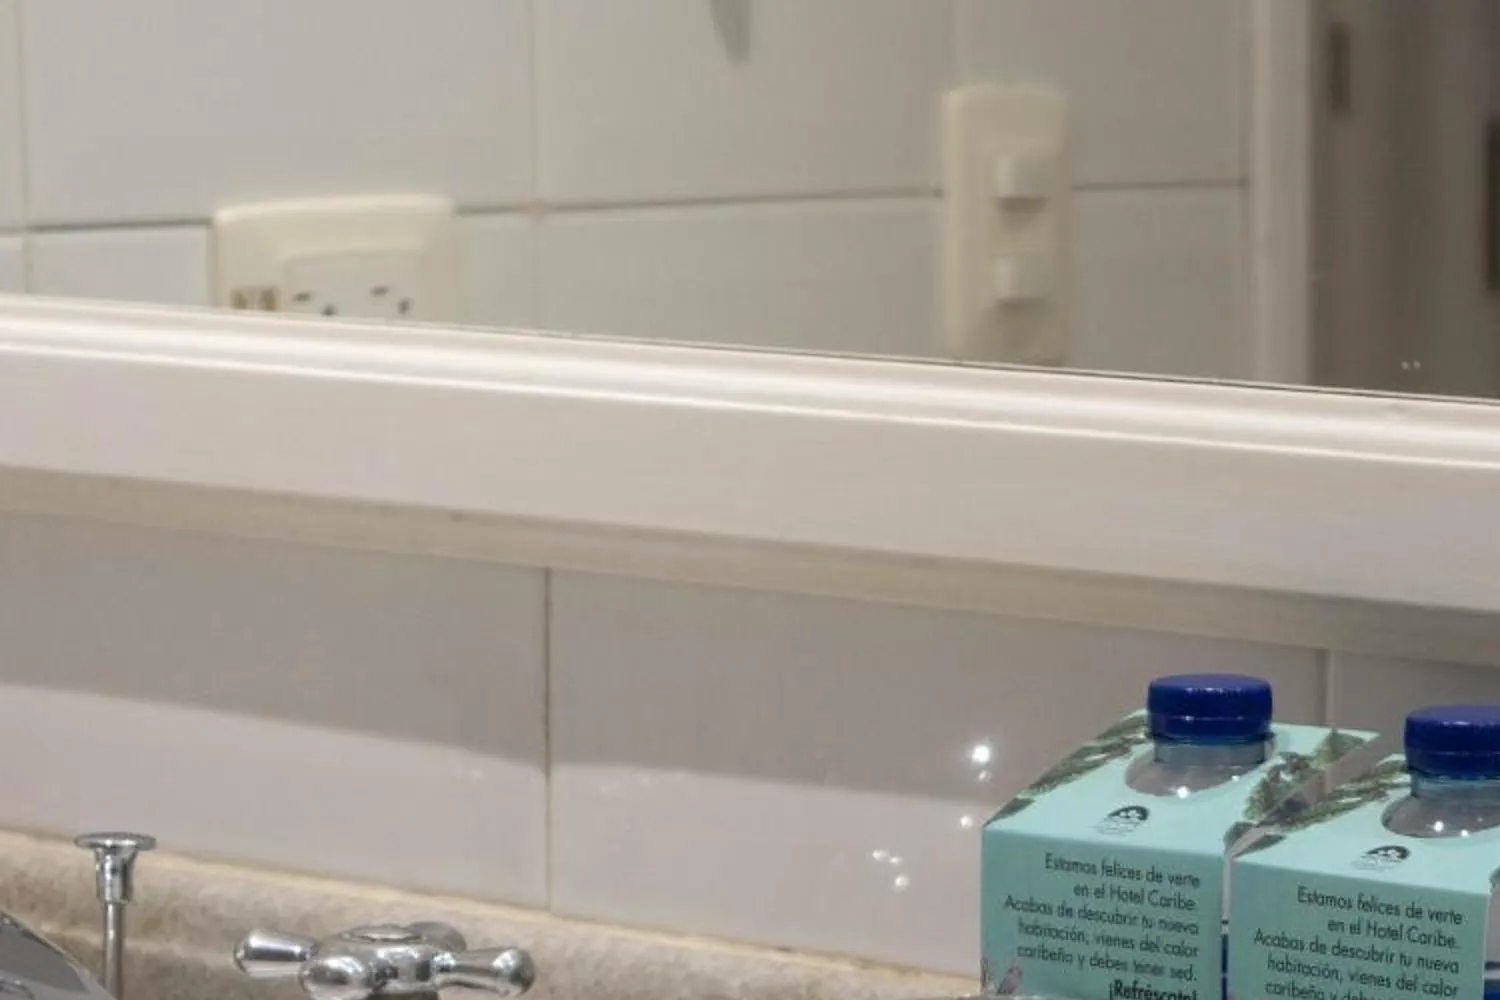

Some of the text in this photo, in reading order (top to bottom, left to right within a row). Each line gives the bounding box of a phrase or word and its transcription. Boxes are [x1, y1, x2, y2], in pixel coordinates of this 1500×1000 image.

[1045, 852, 1200, 889] Estamos felices de verte
[1073, 885, 1089, 899] en
[1094, 884, 1106, 900] el
[1109, 884, 1144, 906] Hotel
[1297, 885, 1462, 926] Estamos felices de verte
[1004, 895, 1199, 936] Acabas de descubrir tu nueva
[1328, 918, 1345, 933] en
[1349, 919, 1361, 935] el
[1366, 921, 1403, 942] Hotel
[1139, 934, 1160, 954] del
[1164, 937, 1199, 958] calor
[1254, 928, 1459, 973] Acabas de descubrir tu nueva
[1076, 954, 1086, 970] y
[1089, 951, 1127, 972] debes
[1170, 963, 1198, 983] sed.
[1267, 950, 1459, 998] habitación, vienes del calor
